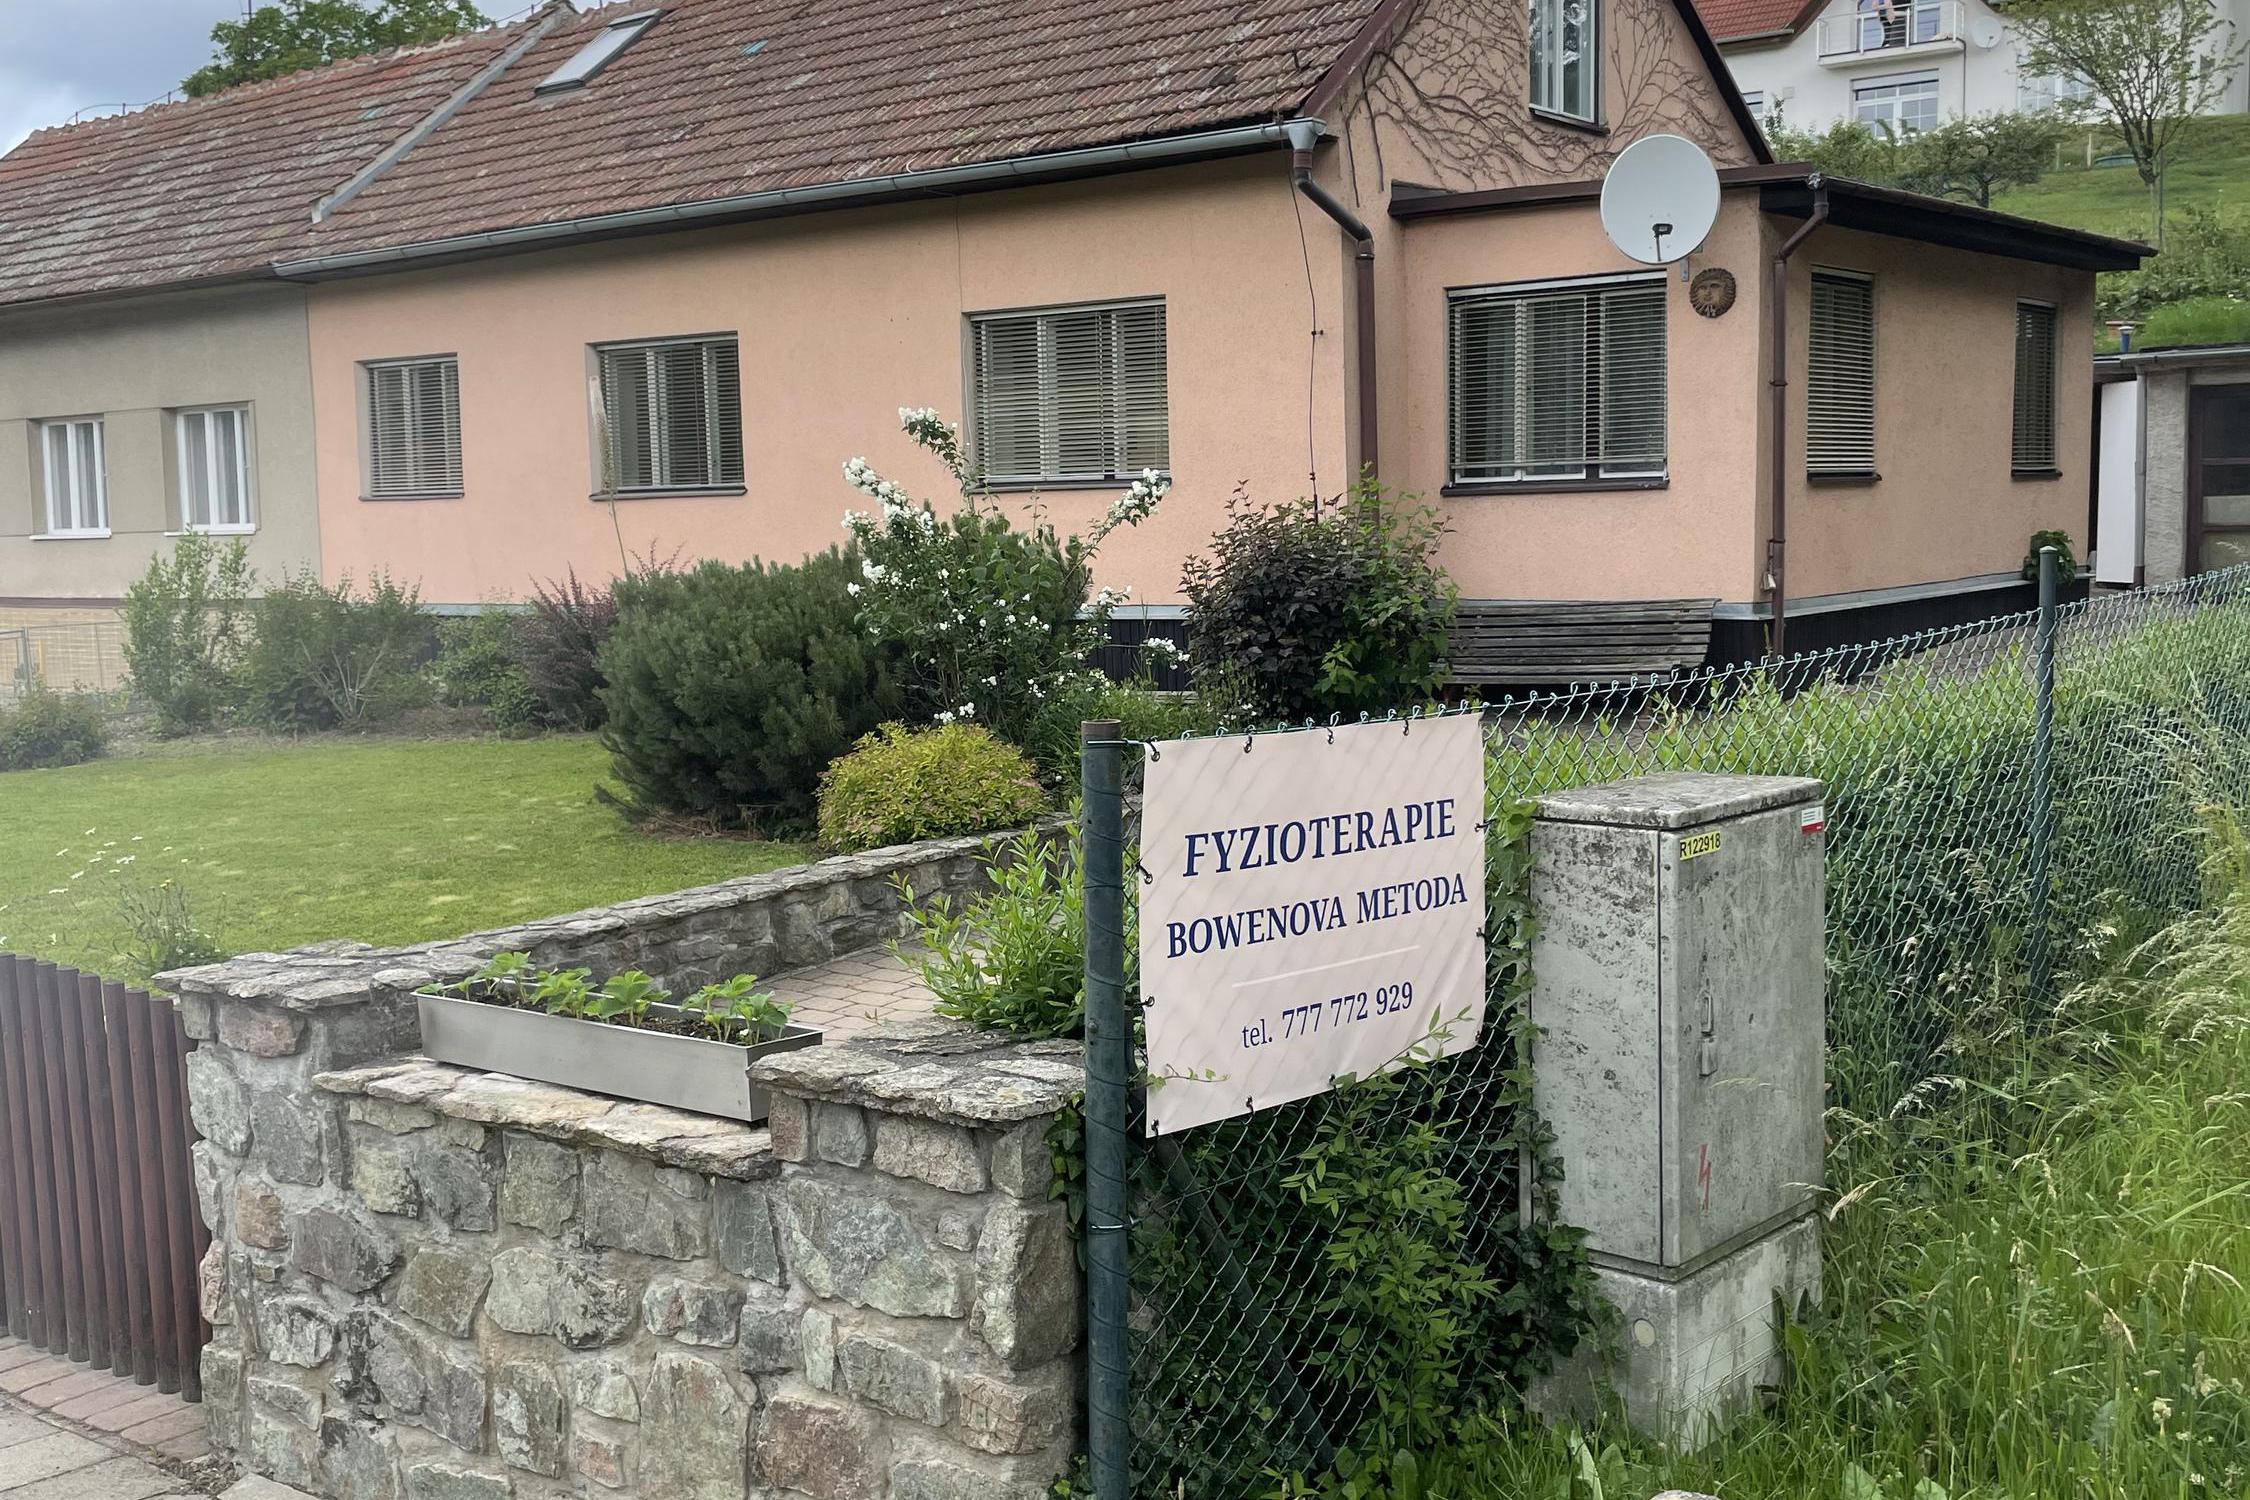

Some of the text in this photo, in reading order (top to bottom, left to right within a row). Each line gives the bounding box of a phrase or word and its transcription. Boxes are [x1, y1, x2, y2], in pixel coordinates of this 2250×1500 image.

[1182, 798, 1456, 877] FYZIOTERAPIE
[1680, 832, 1721, 858] R122918
[1166, 872, 1468, 959] BOWENOVA METODA
[1241, 981, 1413, 1049] tel. 777 772 929
